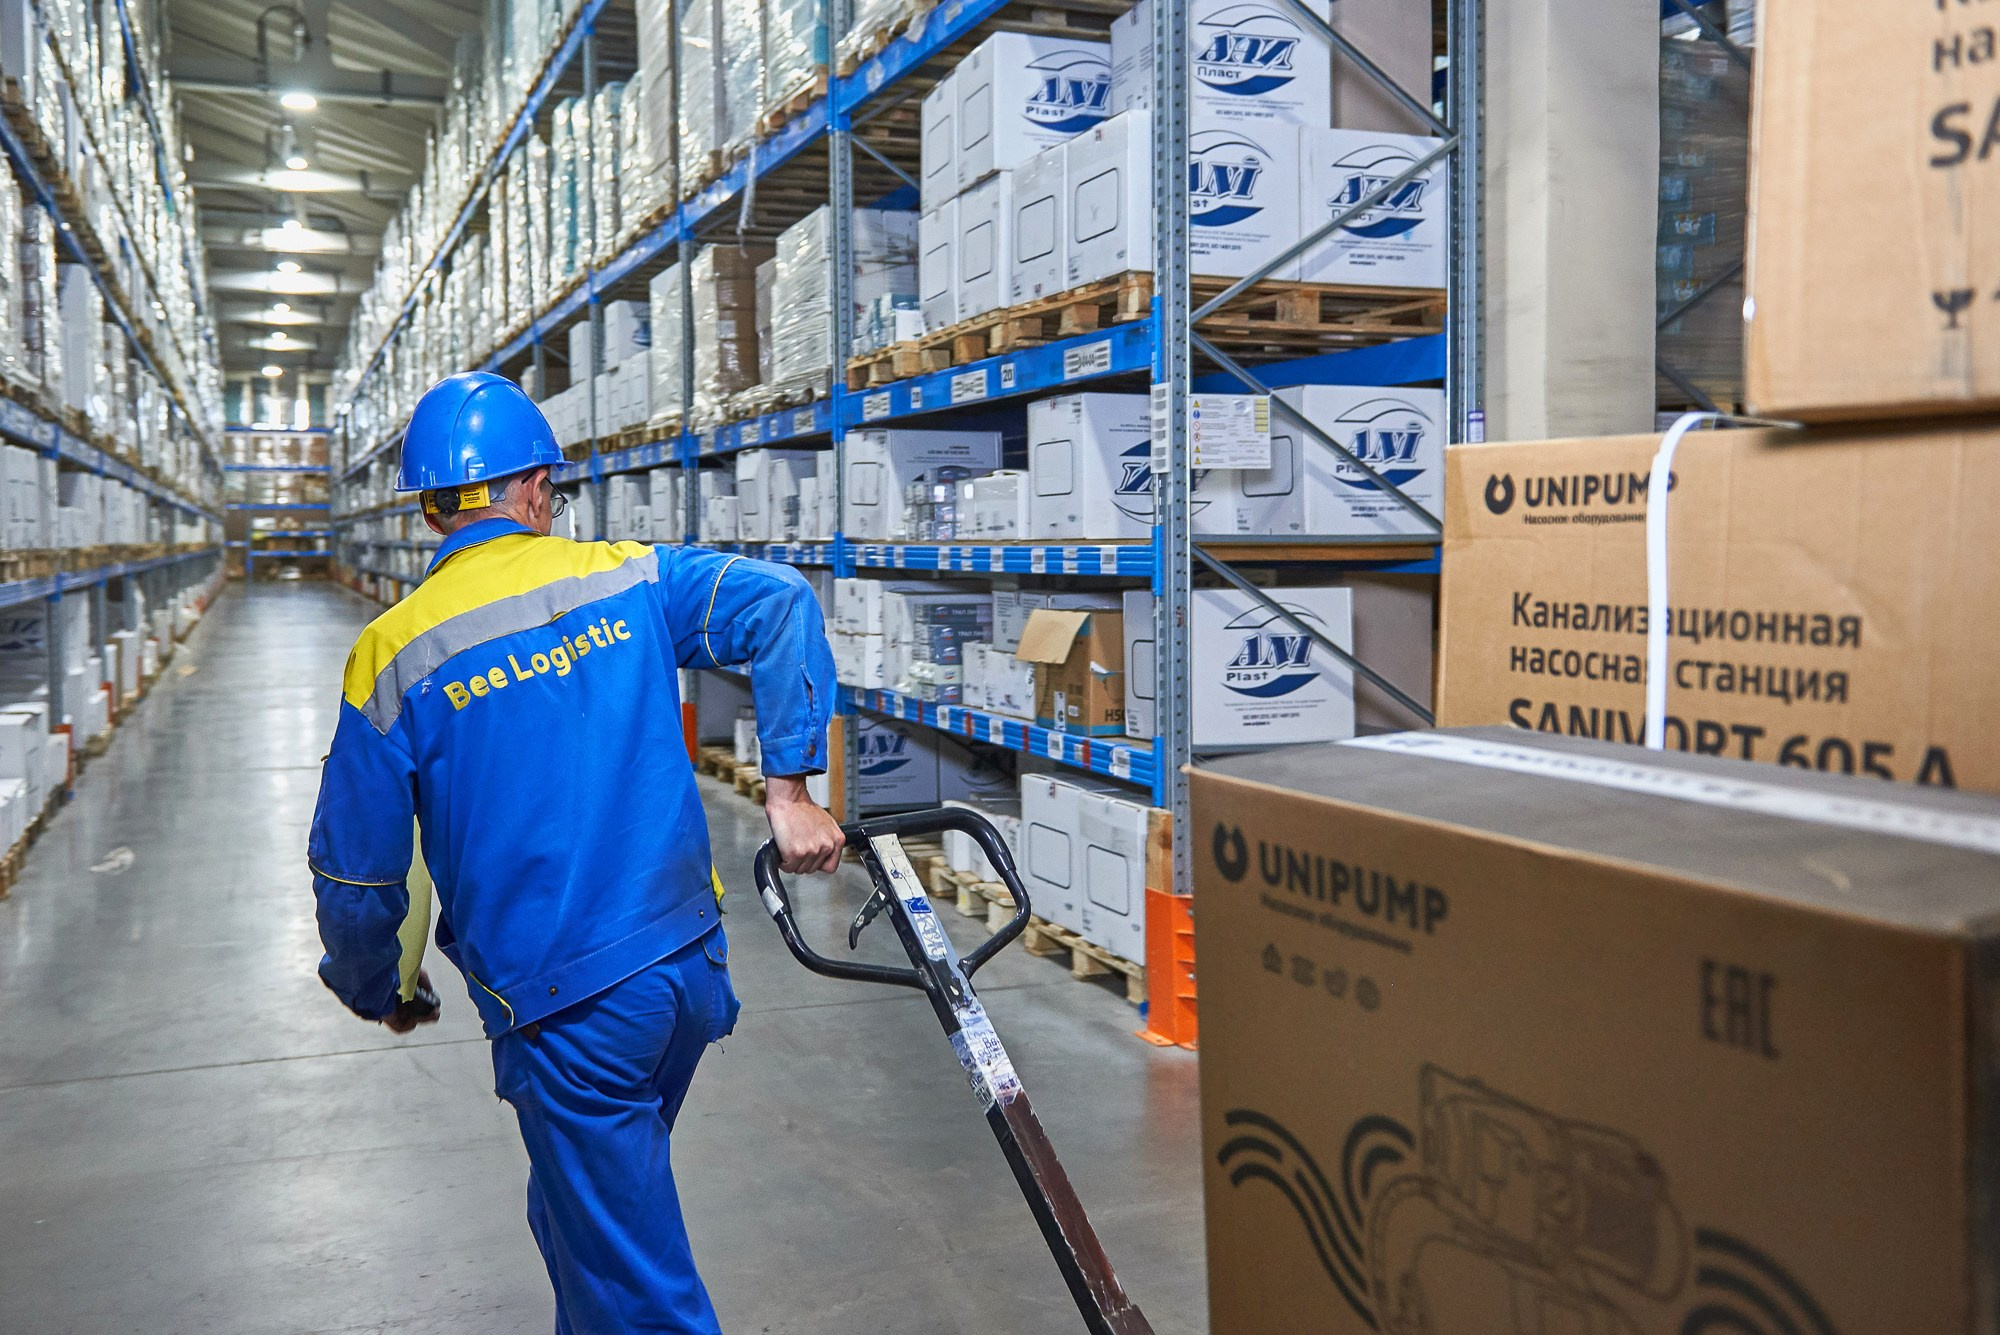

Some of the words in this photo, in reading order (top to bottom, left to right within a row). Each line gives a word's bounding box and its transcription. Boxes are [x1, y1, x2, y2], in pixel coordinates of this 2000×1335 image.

[1197, 66, 1241, 79] Пласт
[1026, 105, 1065, 117] Plast
[1002, 369, 1013, 382] 20
[442, 666, 509, 711] Bee
[507, 617, 631, 681] Logistic
[1226, 671, 1268, 682] Plast
[1510, 646, 1648, 684] насосна
[1675, 658, 1849, 705] станция
[1258, 840, 1449, 935] UNIPUMP
